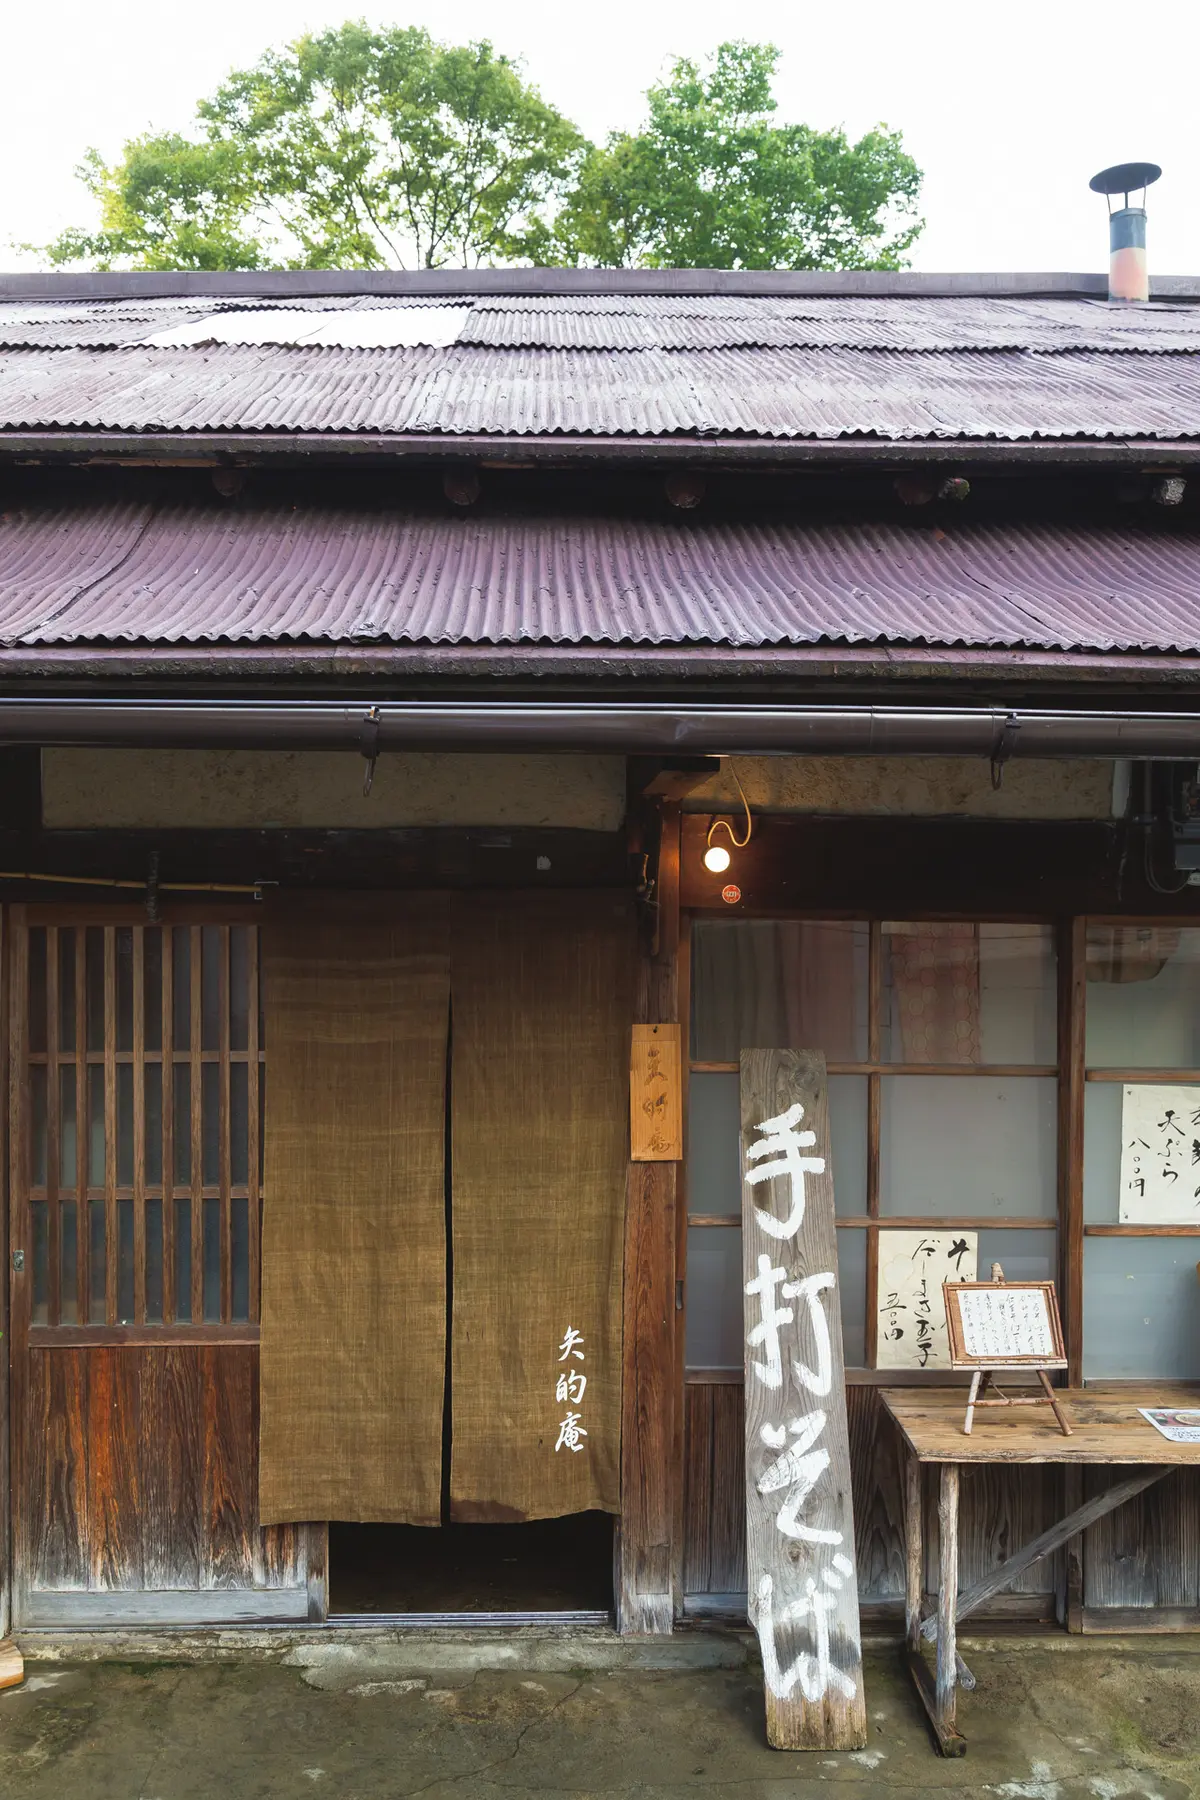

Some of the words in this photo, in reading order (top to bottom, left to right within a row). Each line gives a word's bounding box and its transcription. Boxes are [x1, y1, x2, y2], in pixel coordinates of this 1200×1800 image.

[1157, 1109, 1186, 1188] 天ぷら
[554, 1325, 588, 1453] 矢的庵
[743, 1102, 857, 1704] 手打そば
